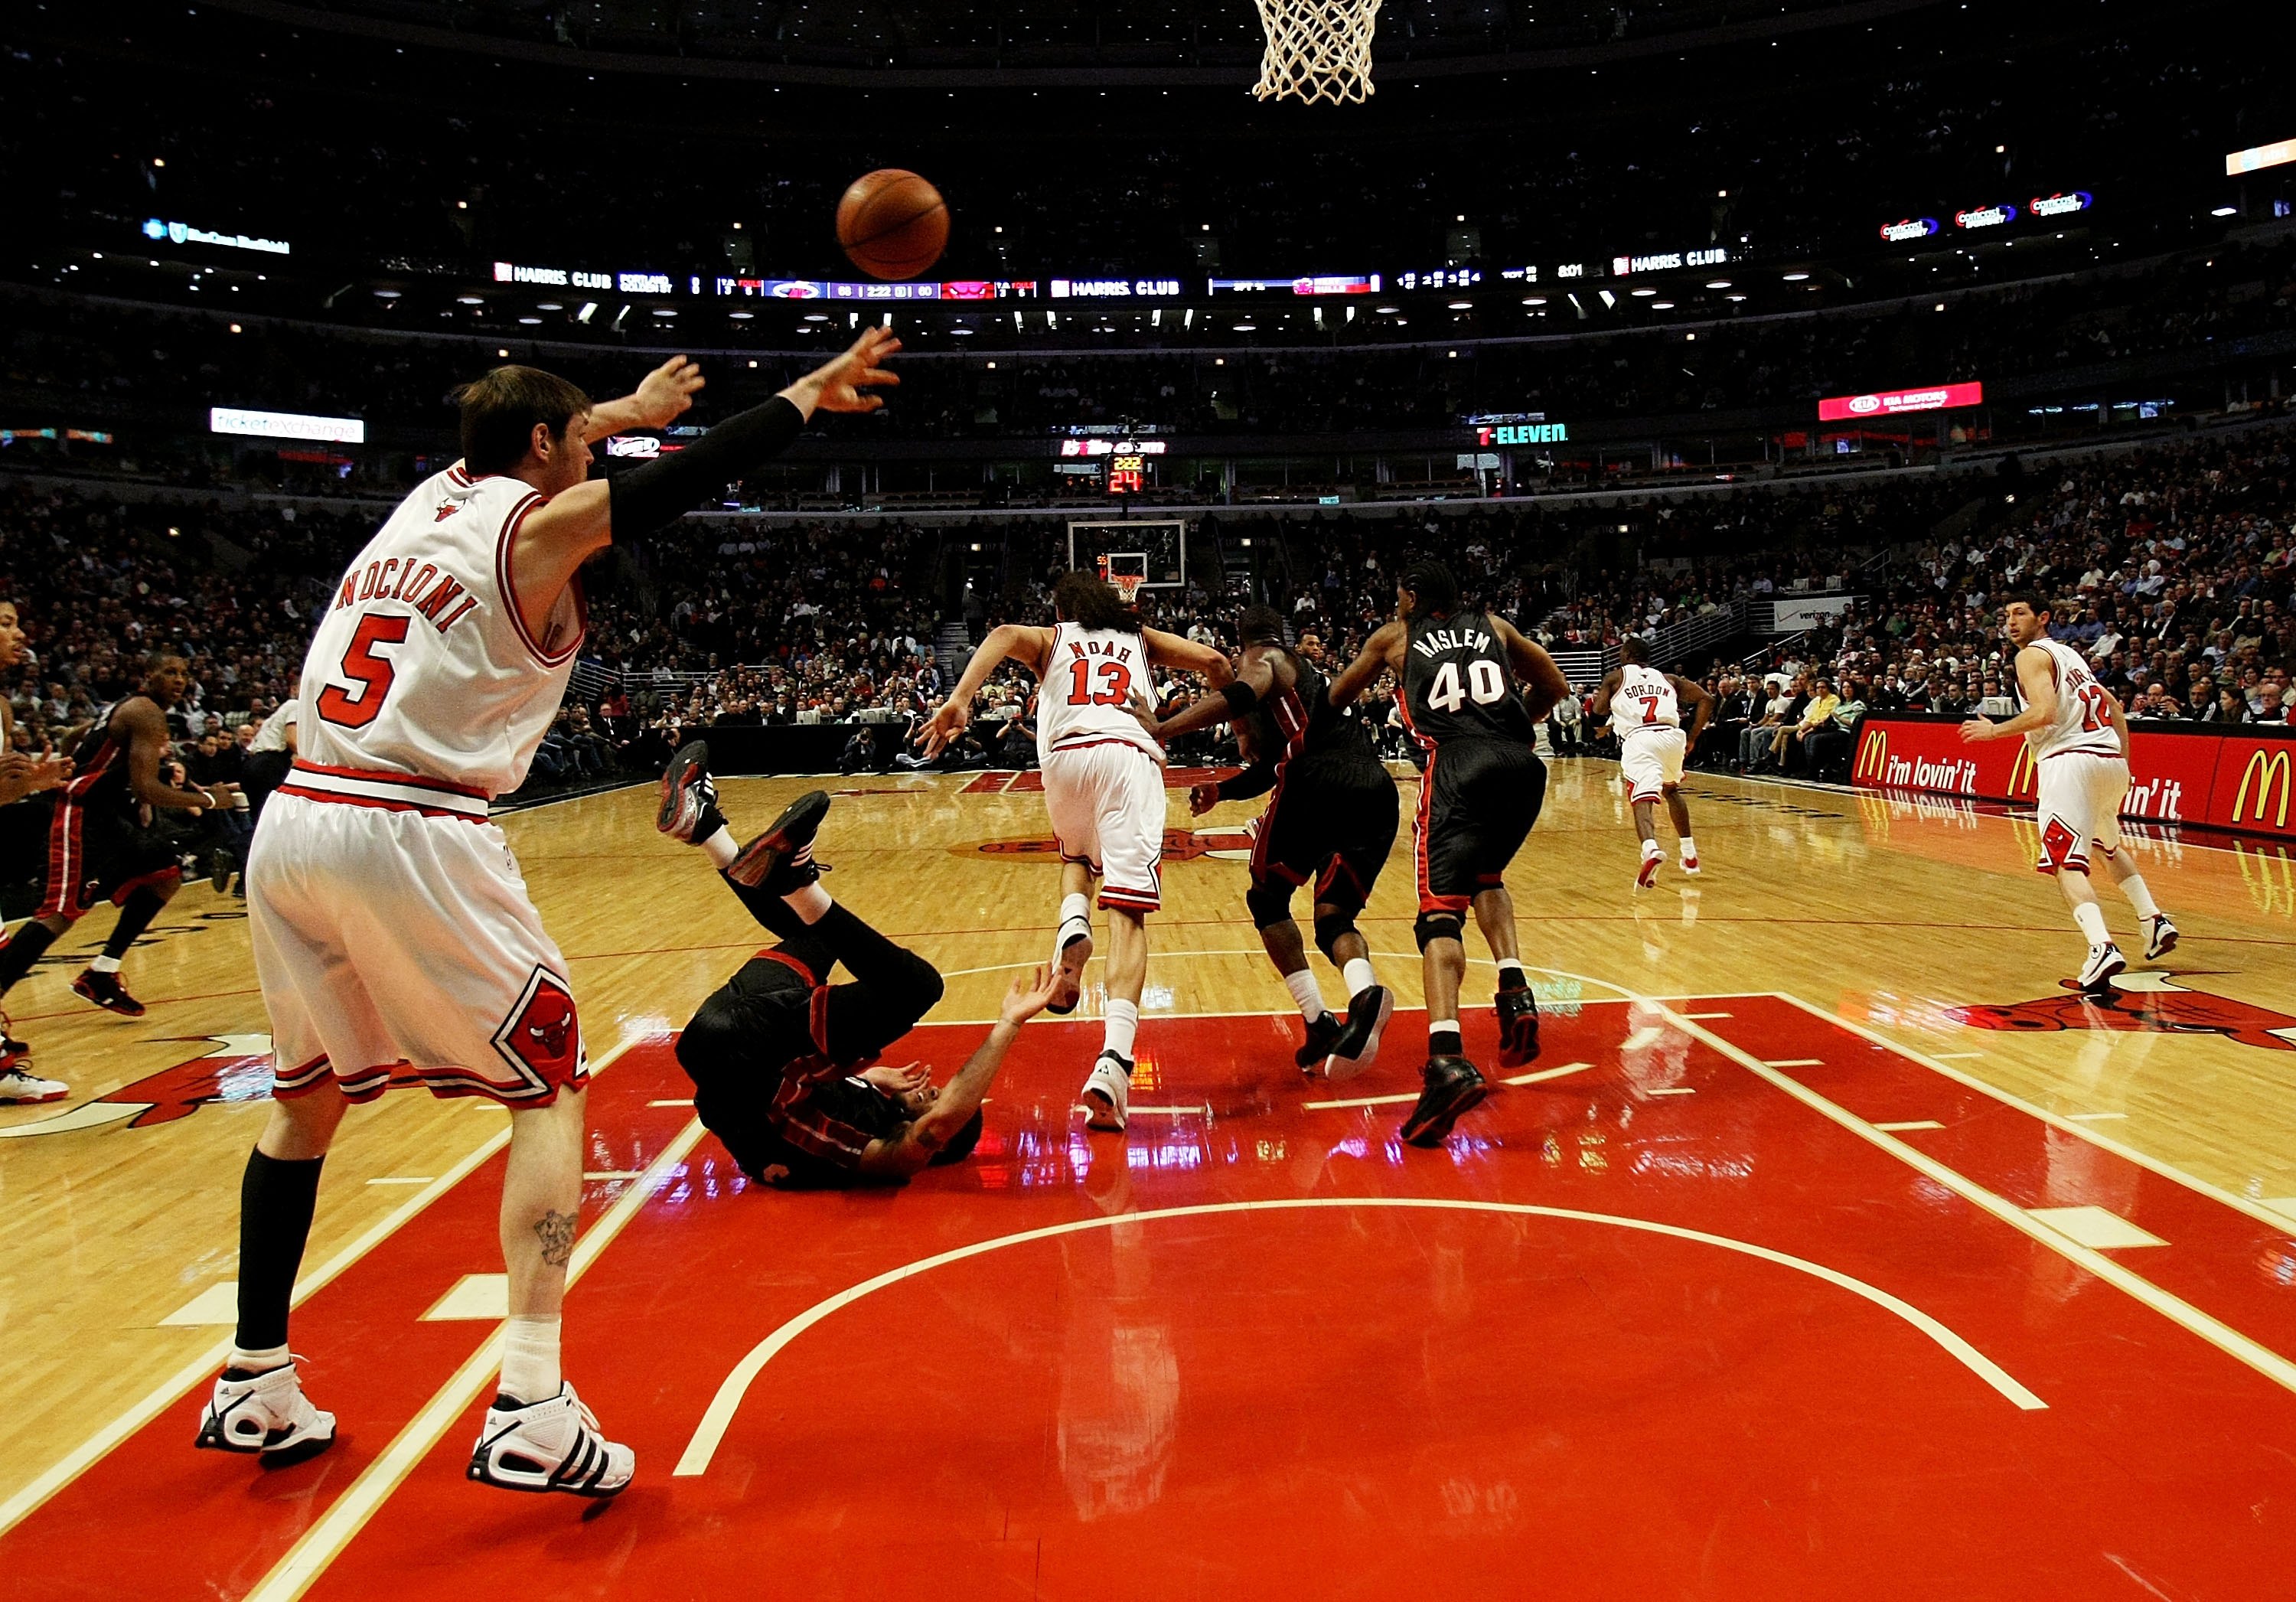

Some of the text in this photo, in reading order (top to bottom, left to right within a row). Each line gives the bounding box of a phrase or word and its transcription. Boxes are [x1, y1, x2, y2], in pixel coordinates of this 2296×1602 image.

[1631, 249, 1726, 272] HARRIS CLUB
[514, 266, 612, 289] HARRIS CLUB
[1072, 280, 1179, 296] HARRIS CLUB
[867, 286, 891, 297] 2:22
[1883, 396, 1902, 406] KIA
[1903, 391, 1948, 404] MOTORS
[217, 415, 357, 442] ticketexchange
[1114, 457, 1141, 470] 2:22
[1110, 471, 1140, 493] 24
[335, 557, 478, 635] NOCIONI
[1068, 641, 1132, 664] NOAH
[1413, 628, 1491, 658] HASLEM
[315, 612, 412, 729] 5
[1067, 658, 1131, 706] 13
[1427, 660, 1505, 713] 40
[1624, 684, 1670, 699] GORDON
[1639, 696, 1658, 723] 7
[2078, 685, 2113, 732] 12
[1886, 755, 1911, 785] i'm
[1913, 755, 1962, 790] lovin'
